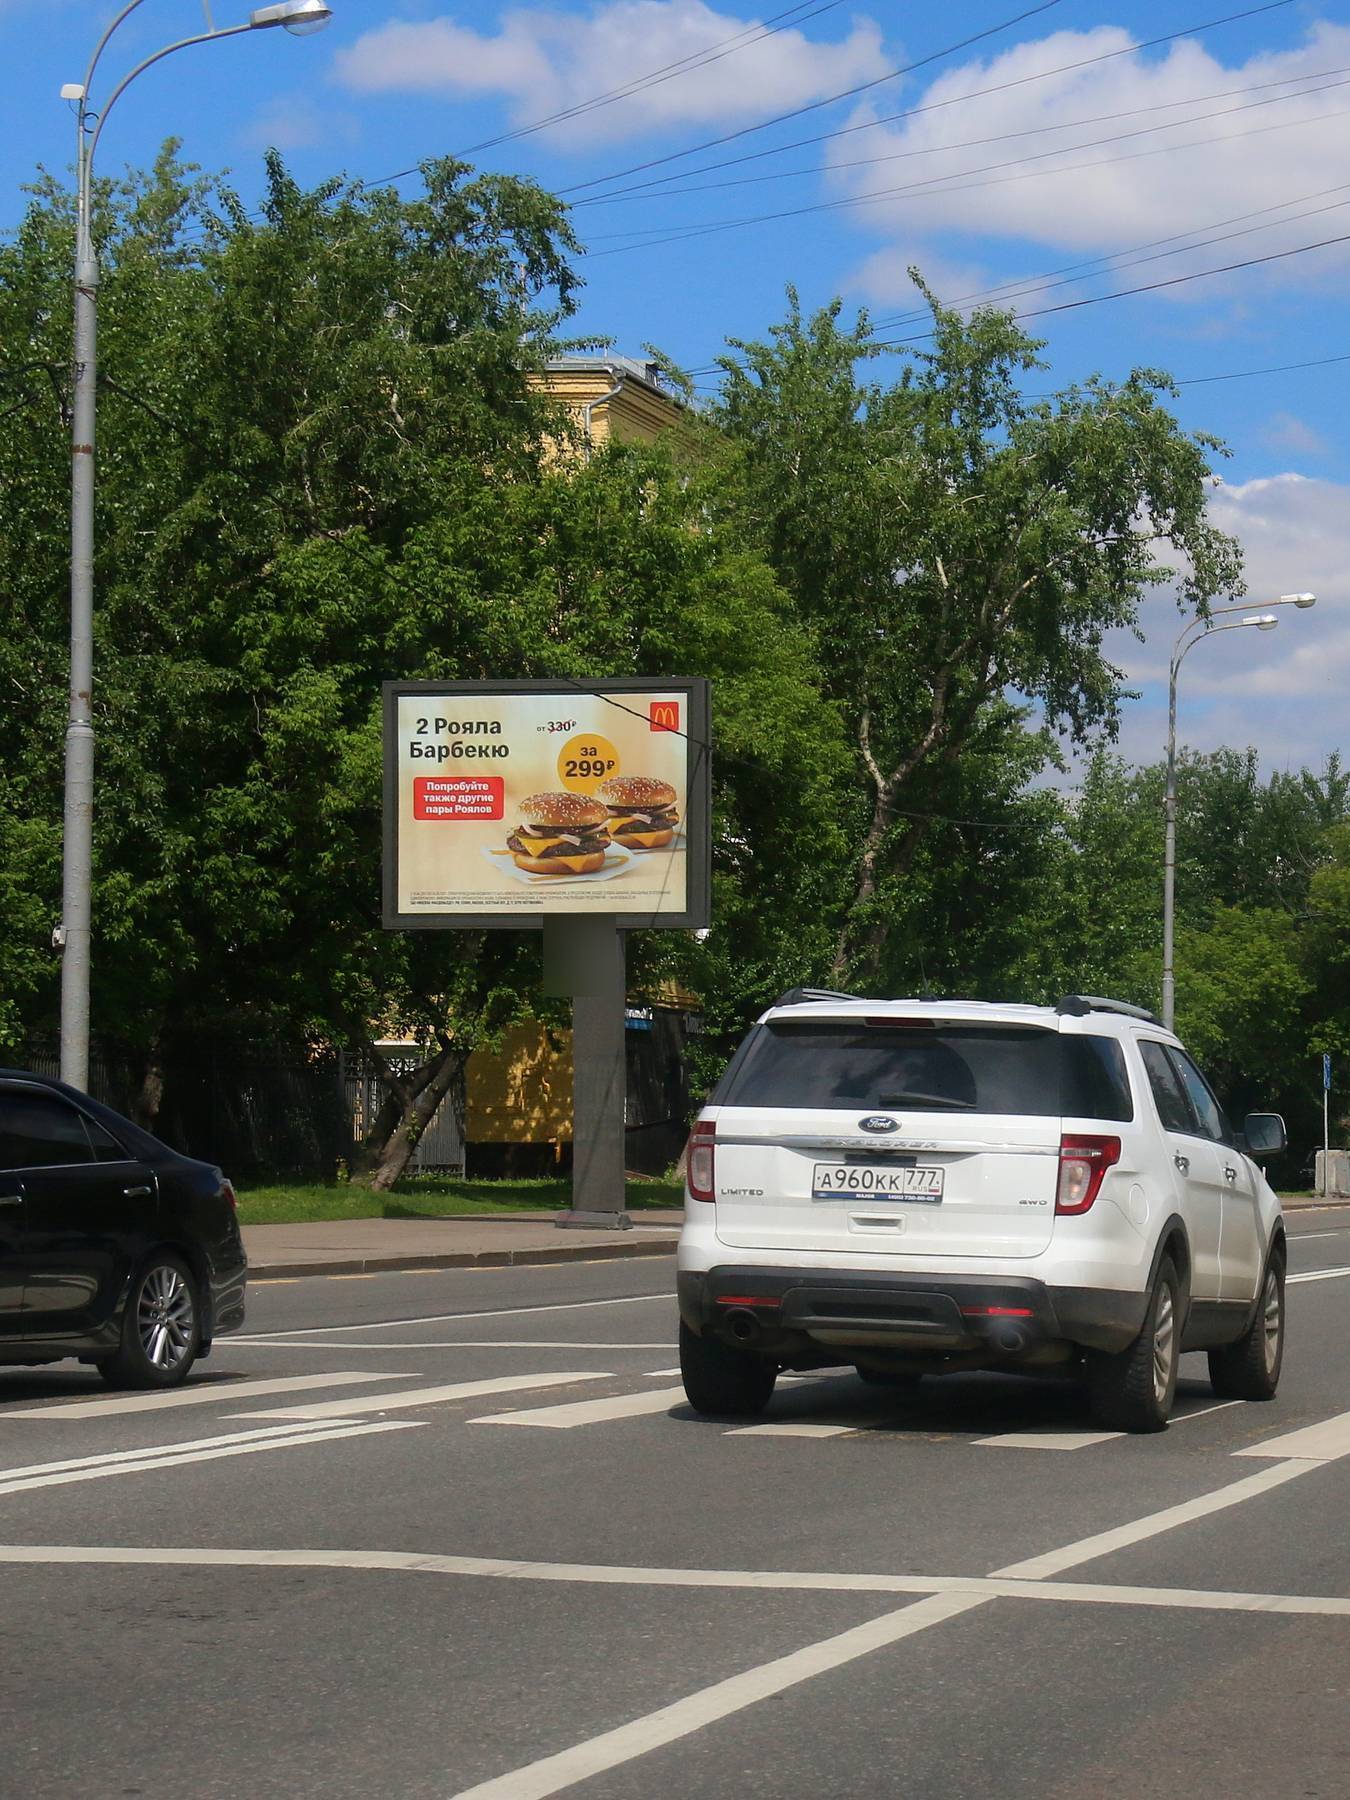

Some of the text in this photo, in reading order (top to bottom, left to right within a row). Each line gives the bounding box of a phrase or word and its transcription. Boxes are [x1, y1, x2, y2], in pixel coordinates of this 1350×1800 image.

[416, 717, 502, 735] 2 Рояла
[409, 741, 510, 763] Барбекю
[580, 747, 597, 757] за
[426, 781, 489, 793] Попробуйте
[423, 794, 494, 804] также другие
[425, 804, 492, 815] пары Роялов
[866, 1117, 891, 1129] Ford
[906, 1170, 937, 1186] 777
[721, 1188, 764, 1196] LIMITED
